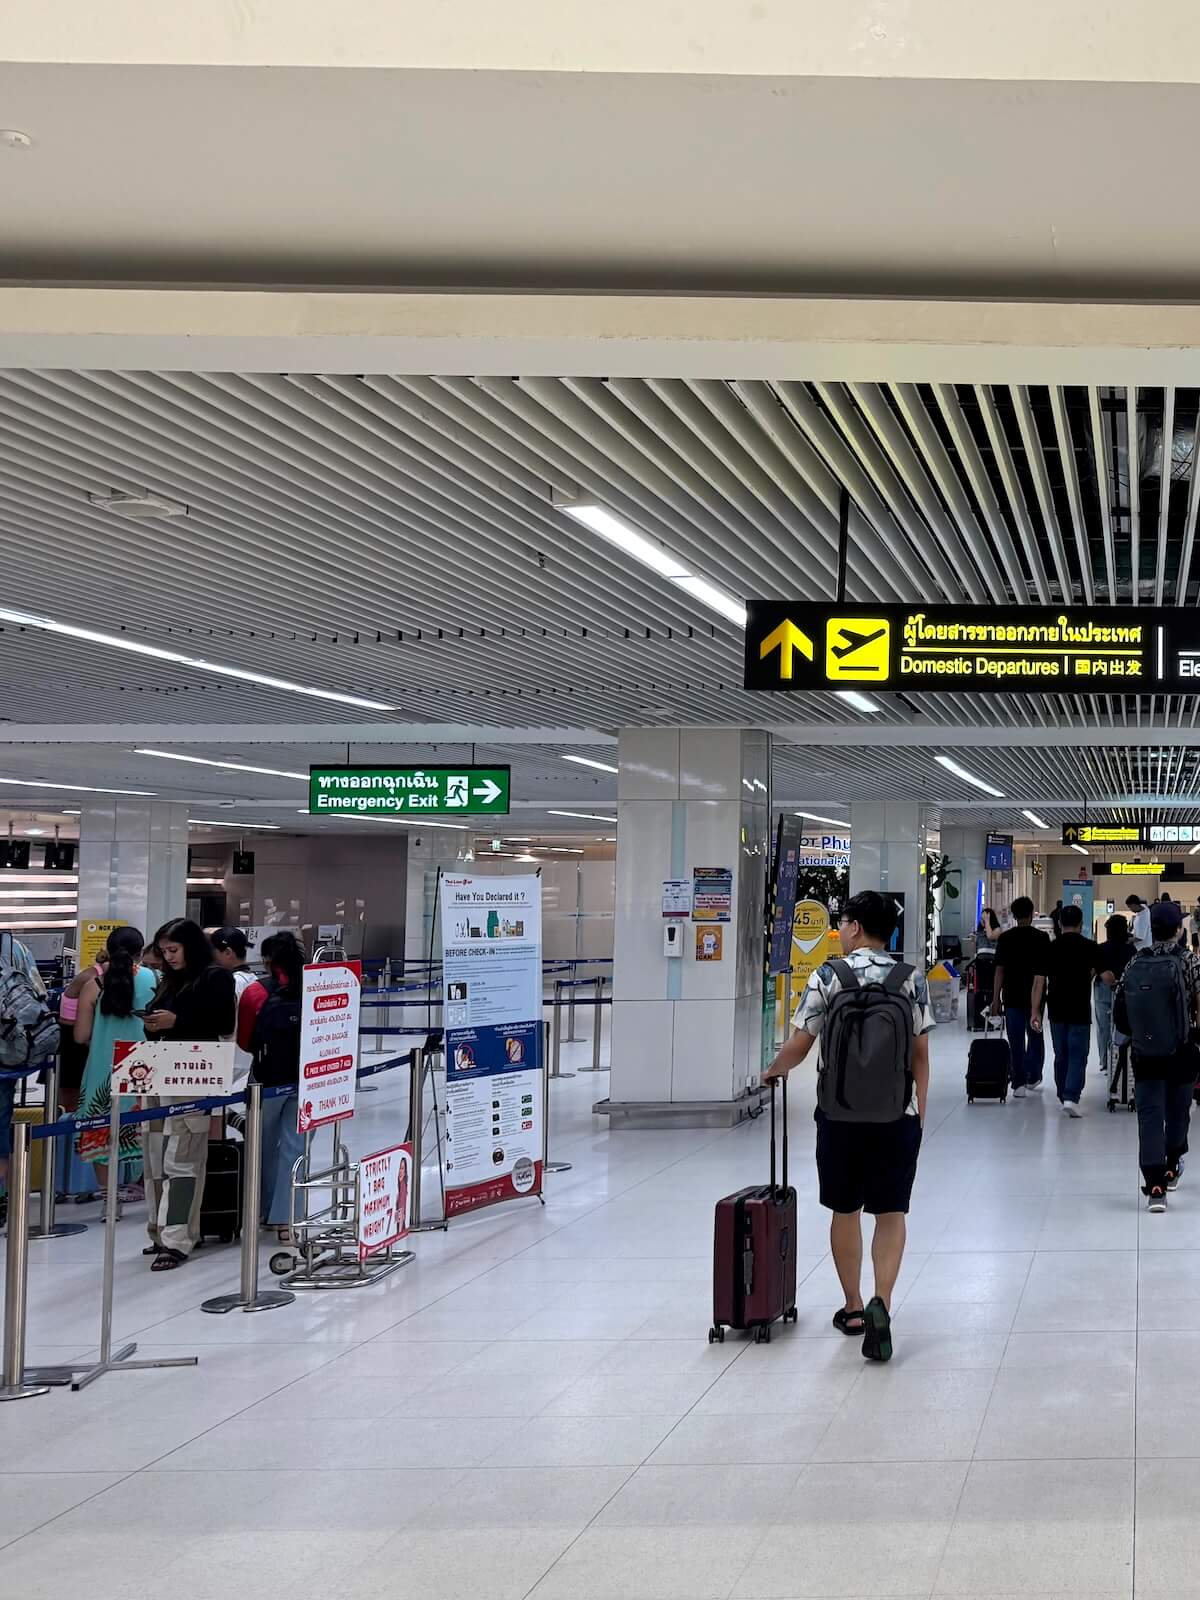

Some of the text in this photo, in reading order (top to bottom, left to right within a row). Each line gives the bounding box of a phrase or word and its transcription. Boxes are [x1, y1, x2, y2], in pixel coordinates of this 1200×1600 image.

[903, 614, 1142, 646] ผู้โดยสารขาออกภายในประเทศ
[900, 656, 1060, 678] Domestic Departures
[1075, 659, 1142, 675] 国内出发
[318, 771, 439, 794] ทางออกฉุกเฉิน
[317, 794, 439, 811] Emergency Exit
[821, 835, 851, 850] Phu
[799, 854, 838, 867] ational
[455, 892, 470, 901] Have
[472, 892, 484, 901] You
[485, 892, 513, 901] Declared
[794, 912, 810, 925] 45
[445, 949, 467, 957] BEFORE
[174, 1059, 213, 1070] ทางเข้า
[164, 1077, 224, 1085] ENTRANCE
[319, 1094, 350, 1111] THANK YOU
[365, 1157, 391, 1177] STRICTLY
[373, 1177, 385, 1193] BAG
[364, 1194, 391, 1216] MAXIMUM
[364, 1217, 385, 1238] WEIGHT
[386, 1208, 393, 1235] 7
